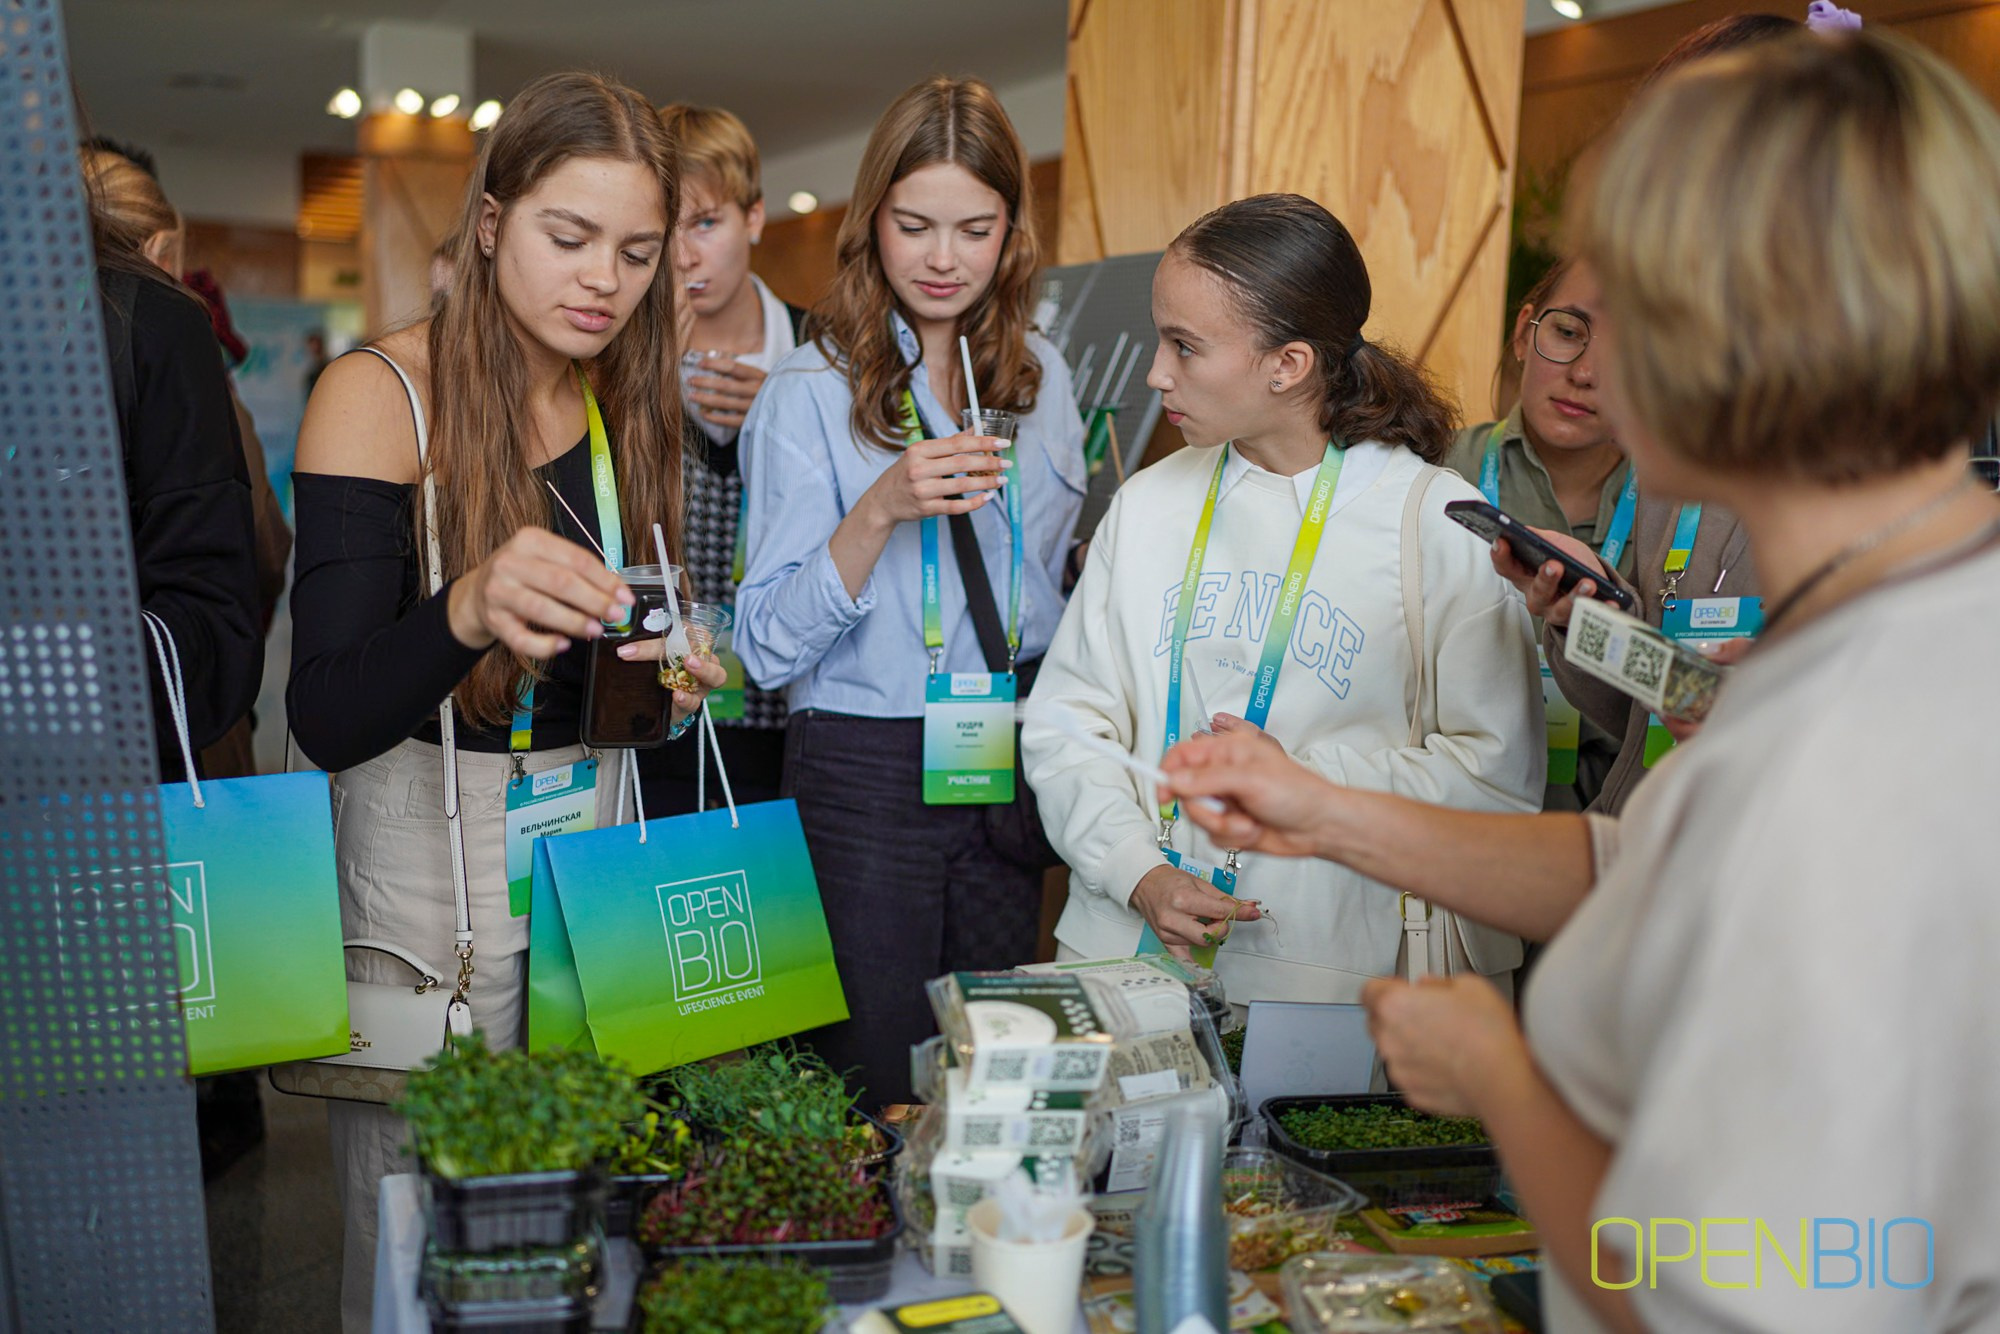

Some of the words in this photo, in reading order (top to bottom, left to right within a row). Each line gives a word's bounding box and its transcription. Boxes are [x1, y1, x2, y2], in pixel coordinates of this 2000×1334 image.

[595, 454, 610, 497] OPENBIO
[1309, 480, 1331, 524] OPENBIO
[1186, 548, 1201, 590] OPENBIO
[1280, 572, 1303, 616] OPENBIO
[1694, 607, 1735, 619] OPENBIO
[1172, 640, 1182, 683] OPENBIO
[1254, 665, 1275, 709] OPENBIO
[520, 811, 581, 835] ВЕЛЬЧИНСКАЯ
[667, 883, 744, 926] OPEN
[674, 921, 753, 991] BIO
[678, 992, 736, 1016] LIFESCIENCE
[736, 985, 765, 1001] EVENT
